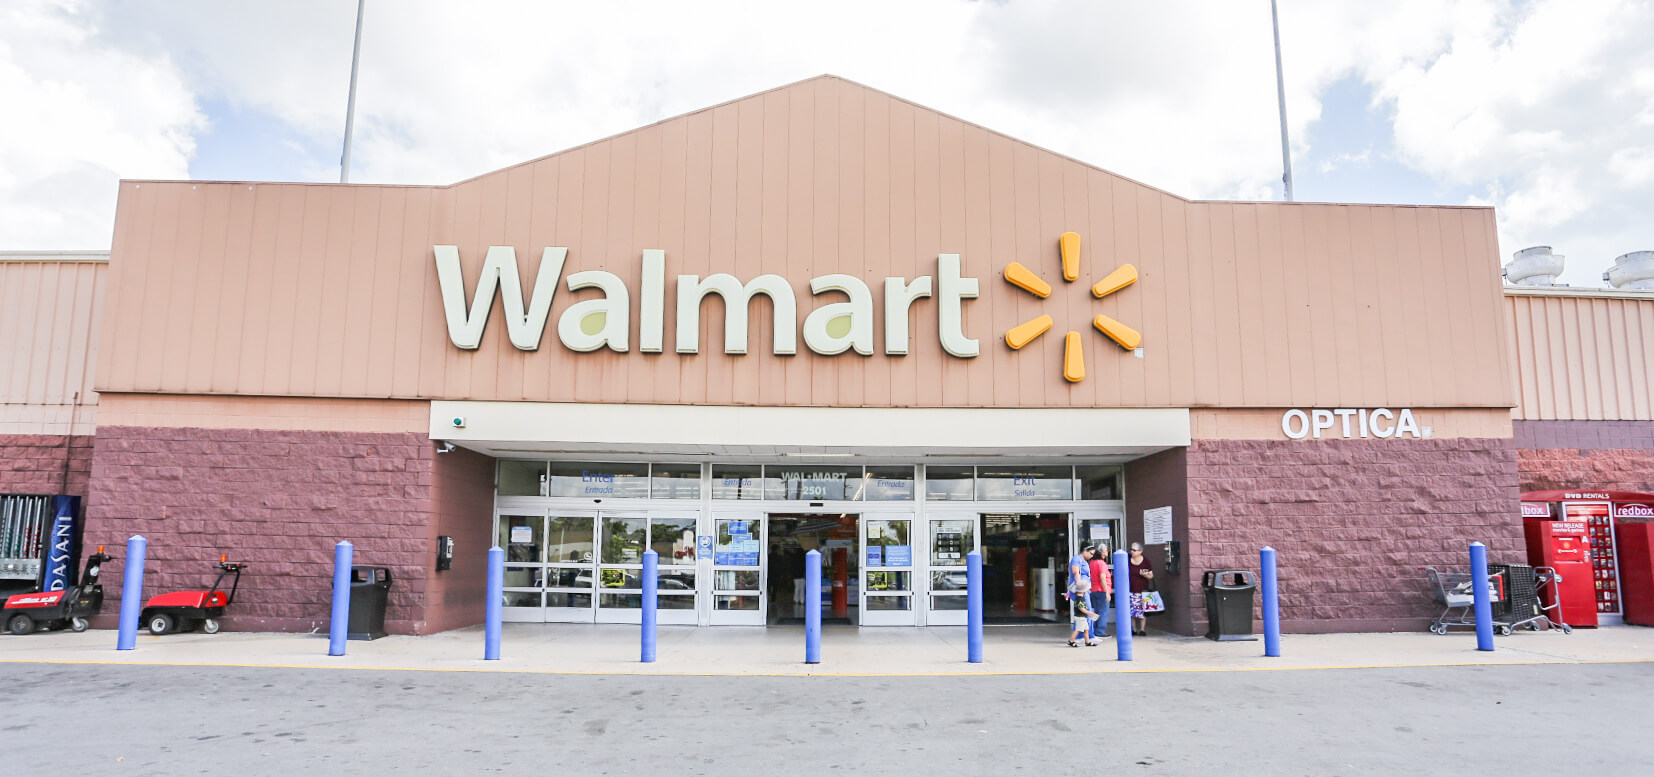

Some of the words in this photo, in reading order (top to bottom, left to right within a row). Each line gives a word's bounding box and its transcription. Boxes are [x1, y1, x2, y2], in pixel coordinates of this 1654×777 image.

[433, 244, 980, 358] Walmart
[1281, 408, 1421, 439] OPTICA
[582, 471, 613, 483] Enter
[1013, 474, 1036, 486] Exit
[723, 478, 752, 486] Entrada
[877, 479, 905, 488] Entrada
[584, 486, 613, 494] Entrada
[802, 486, 826, 495] 2501
[1014, 489, 1035, 497] Salida
[1617, 506, 1654, 515] redbox
[51, 516, 72, 591] DASANI
